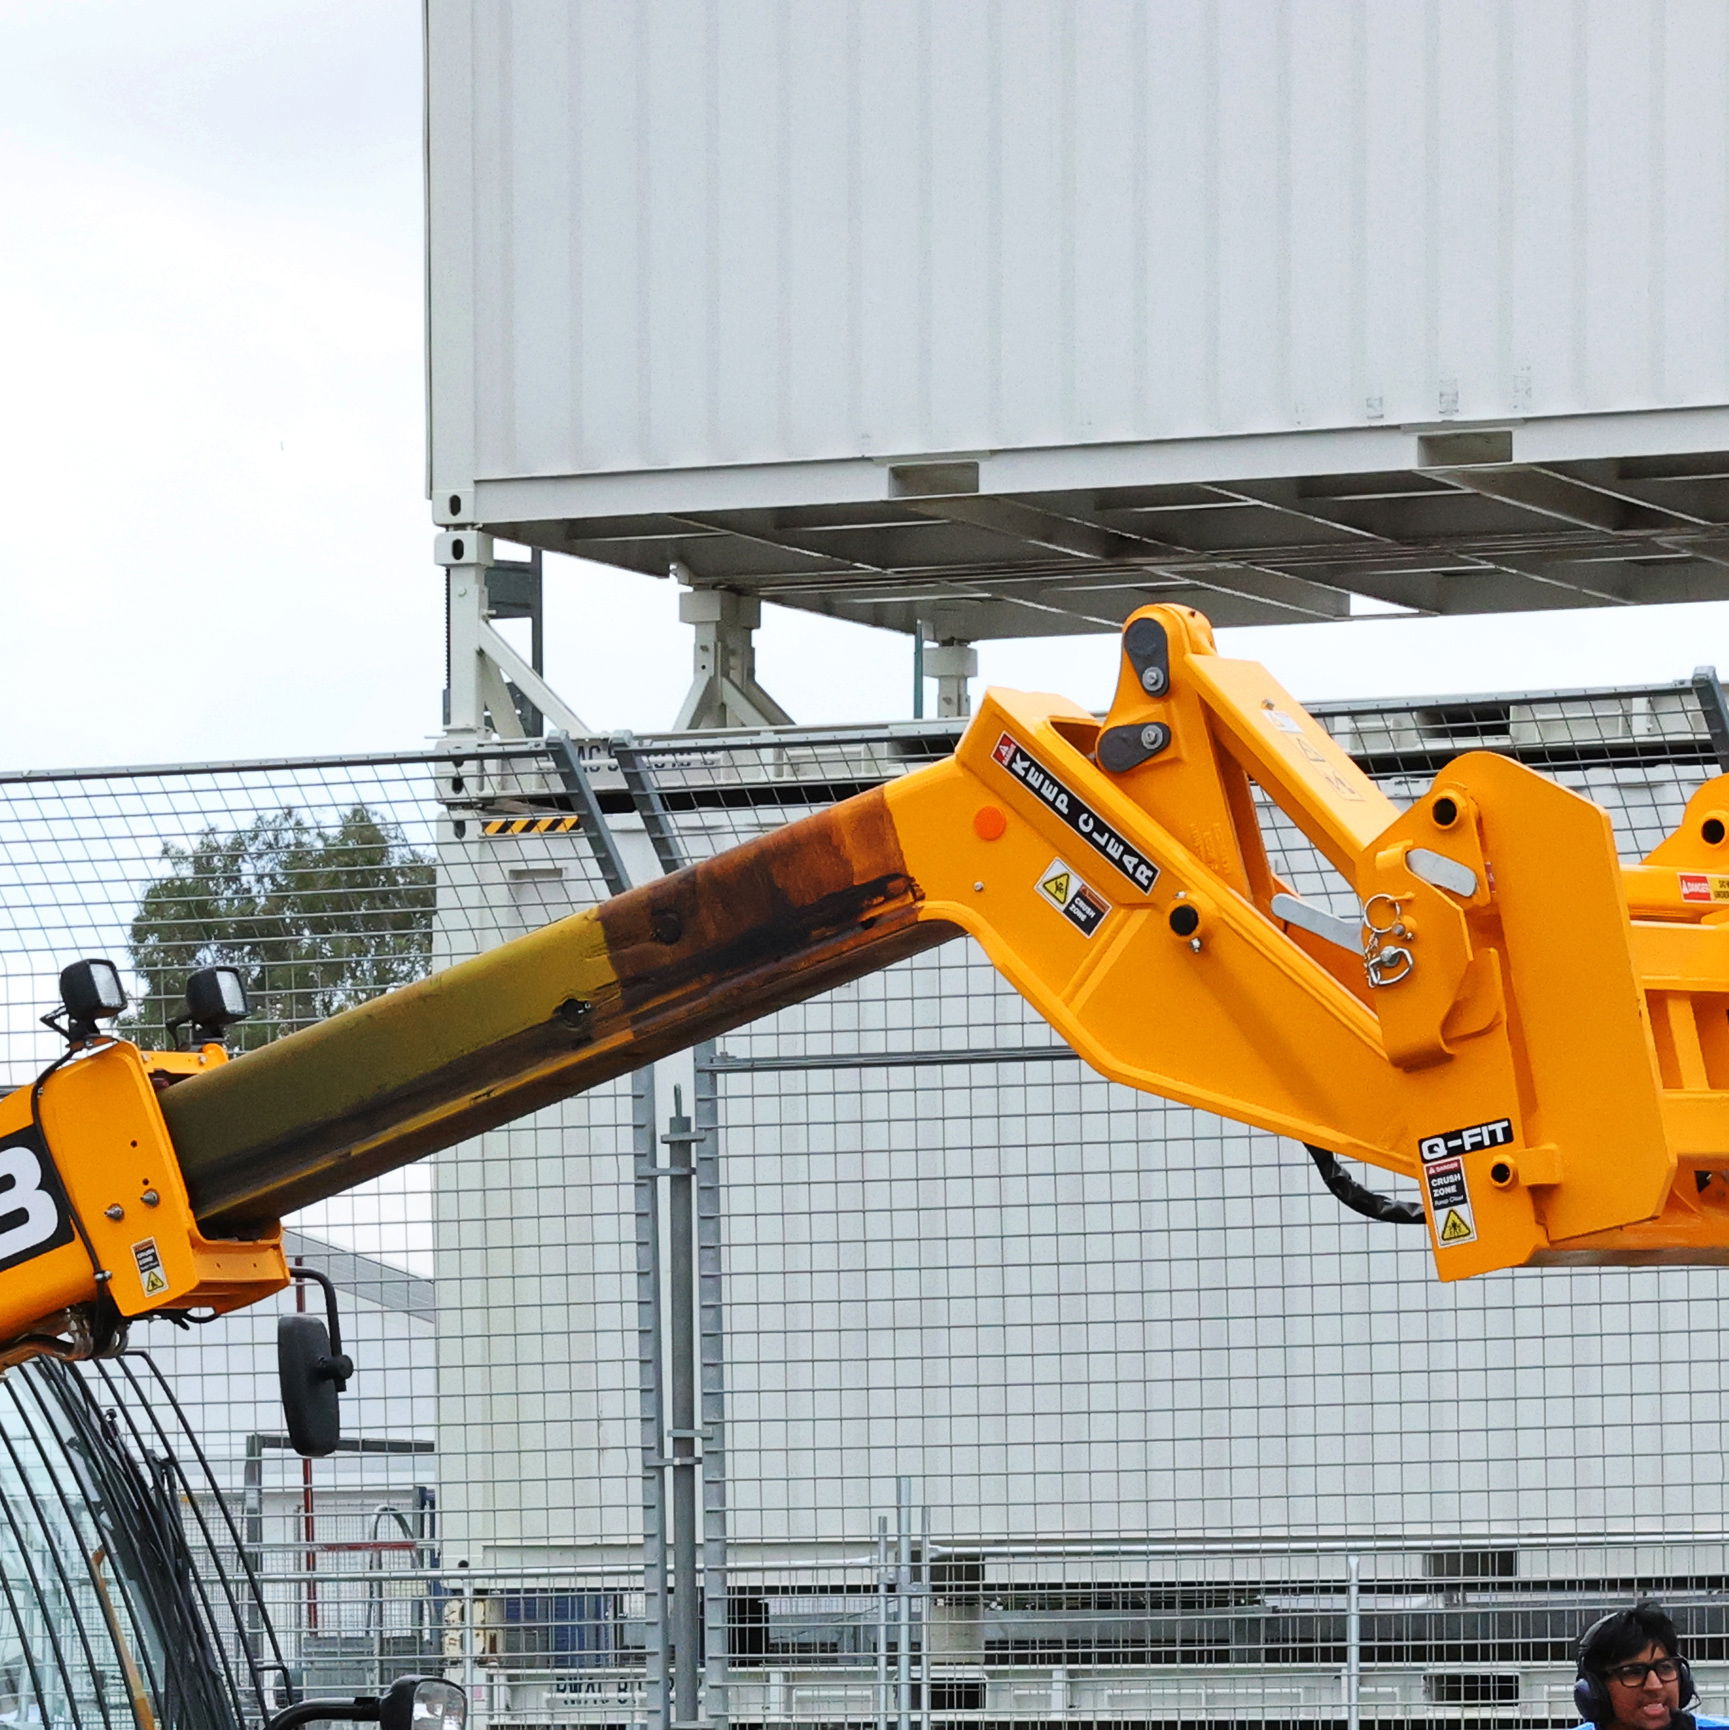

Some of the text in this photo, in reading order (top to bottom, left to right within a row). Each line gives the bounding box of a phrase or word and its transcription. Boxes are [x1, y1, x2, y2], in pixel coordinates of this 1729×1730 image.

[1011, 753, 1070, 815] KEEP
[1078, 813, 1154, 887] CLEAR
[1421, 1120, 1509, 1161] Q-FIT
[1431, 1173, 1461, 1187] CRUSH
[1433, 1185, 1457, 1197] ZONE
